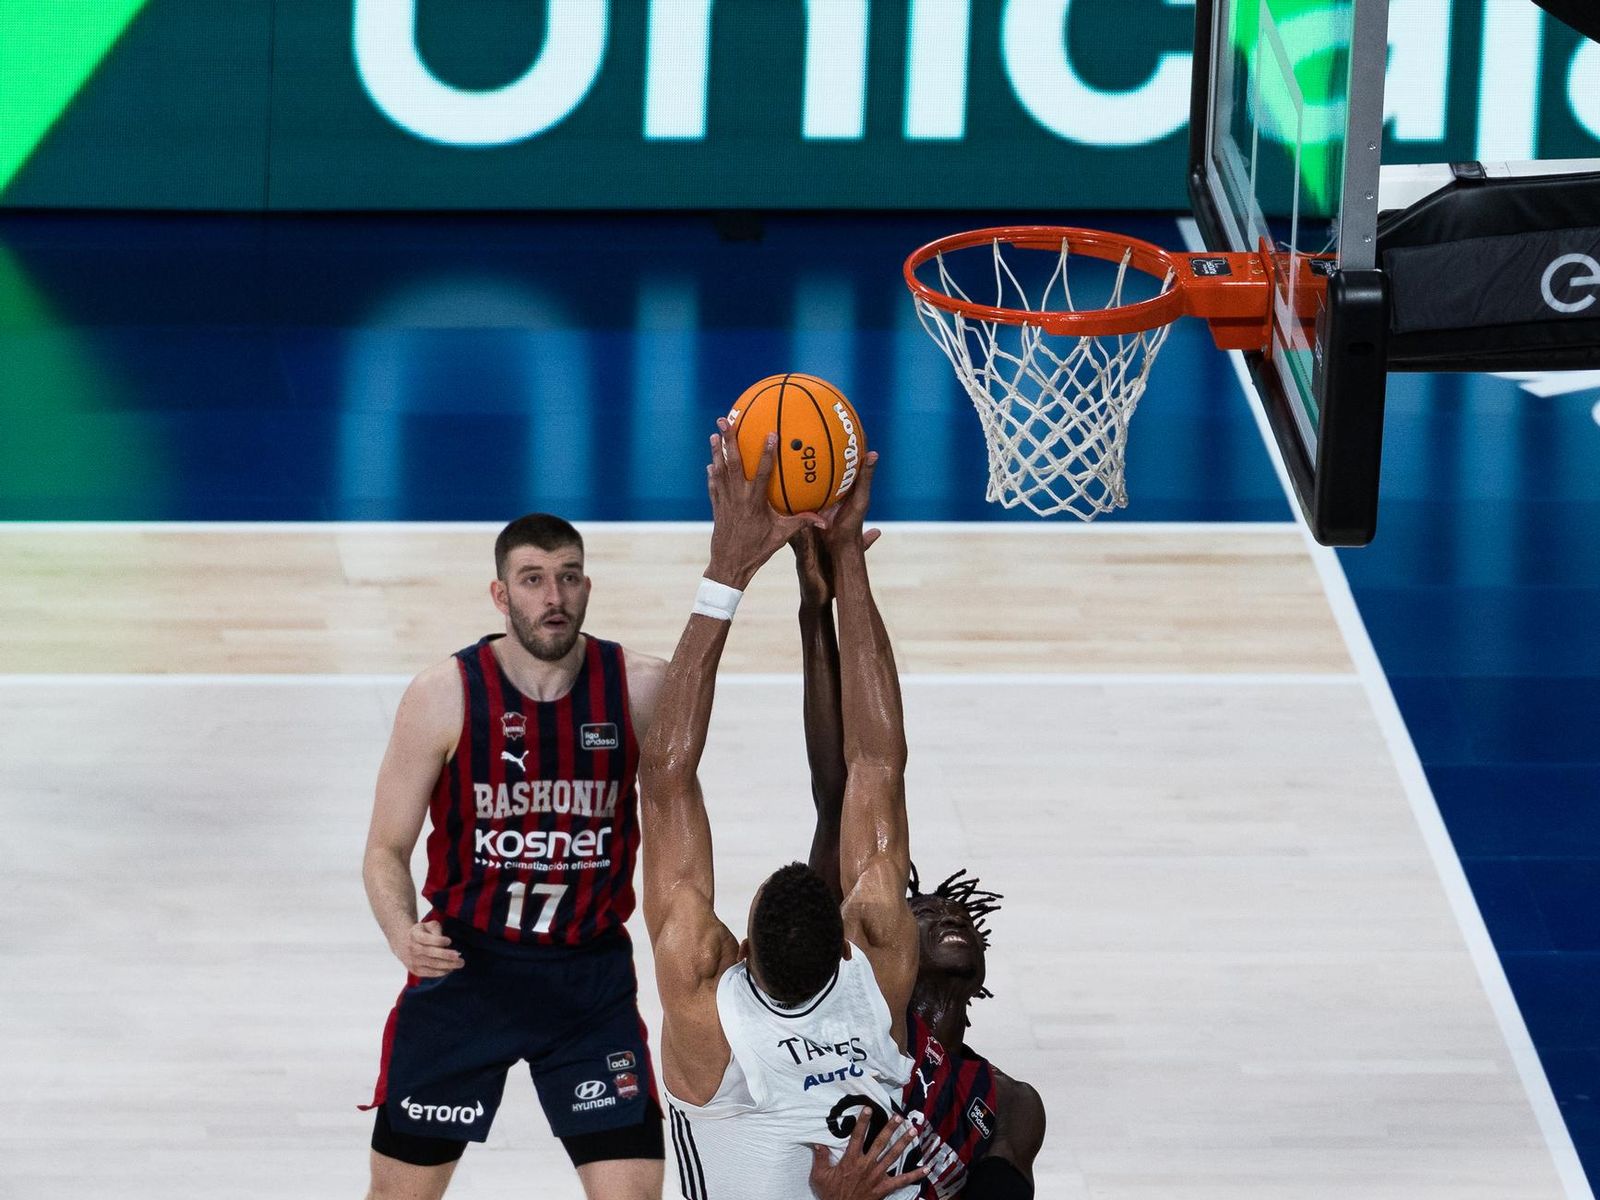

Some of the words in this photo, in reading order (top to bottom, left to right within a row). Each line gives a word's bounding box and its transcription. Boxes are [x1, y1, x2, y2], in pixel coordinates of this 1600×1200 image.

[801, 446, 817, 484] acb
[832, 402, 859, 496] Wilson
[474, 779, 618, 819] BASKONIA
[571, 859, 611, 870] eficiente
[505, 881, 568, 934] 17
[572, 1096, 616, 1112] HYUNDAI
